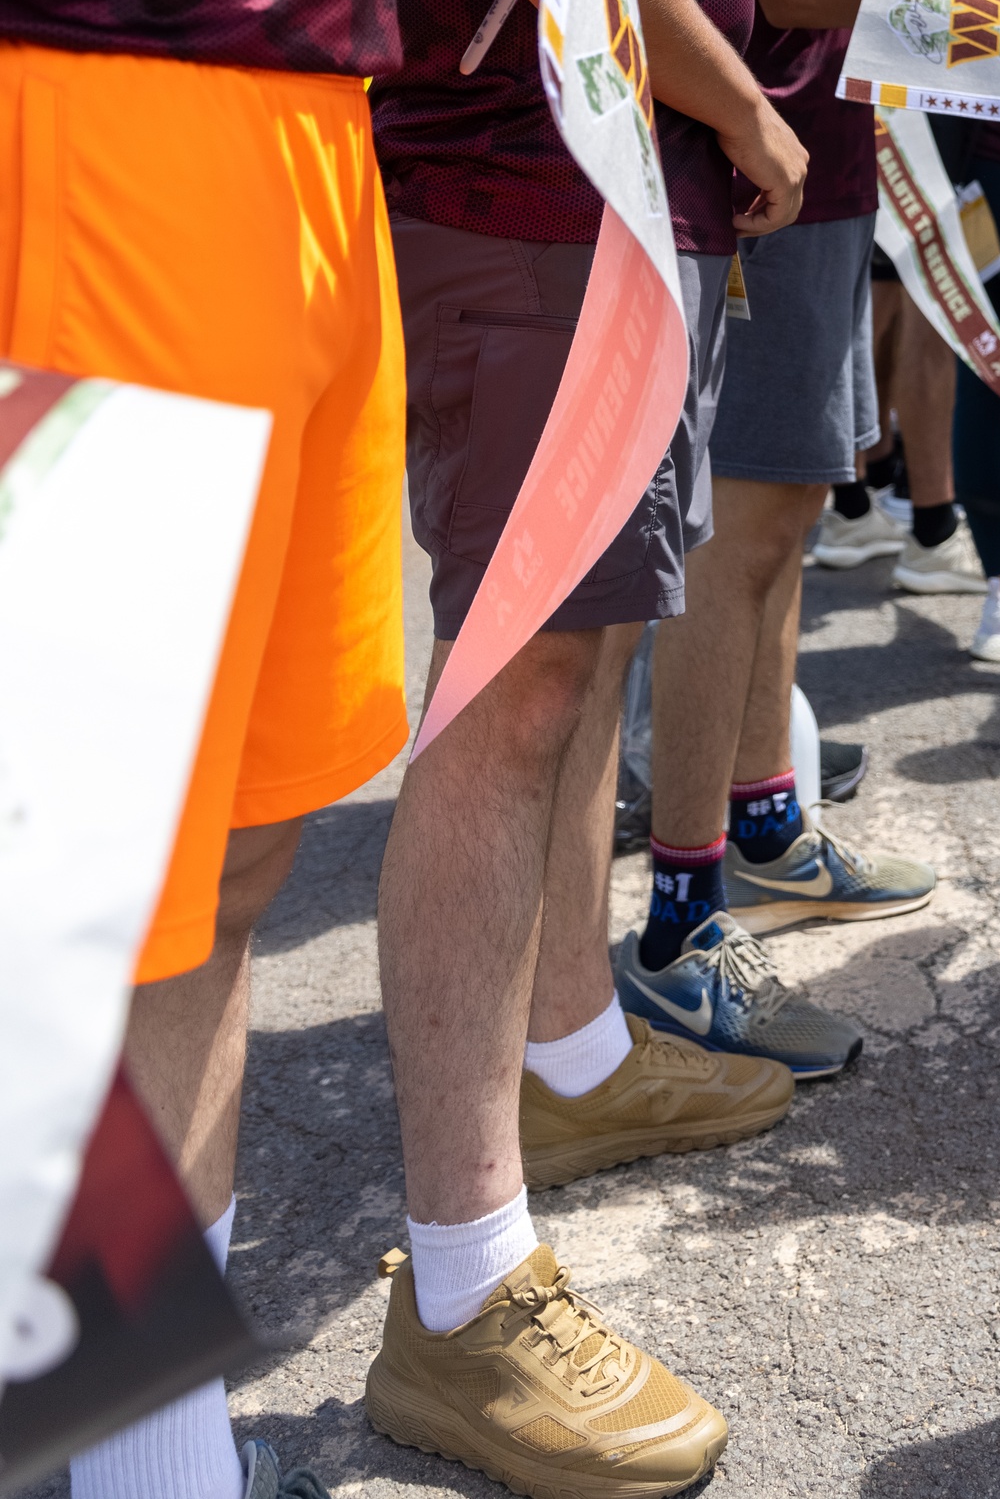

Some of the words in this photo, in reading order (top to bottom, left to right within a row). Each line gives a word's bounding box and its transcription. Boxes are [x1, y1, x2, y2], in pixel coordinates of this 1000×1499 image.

[876, 147, 924, 221] SALUTE
[914, 213, 936, 245] TO
[923, 241, 974, 324] SERVICE
[654, 872, 694, 903] #1
